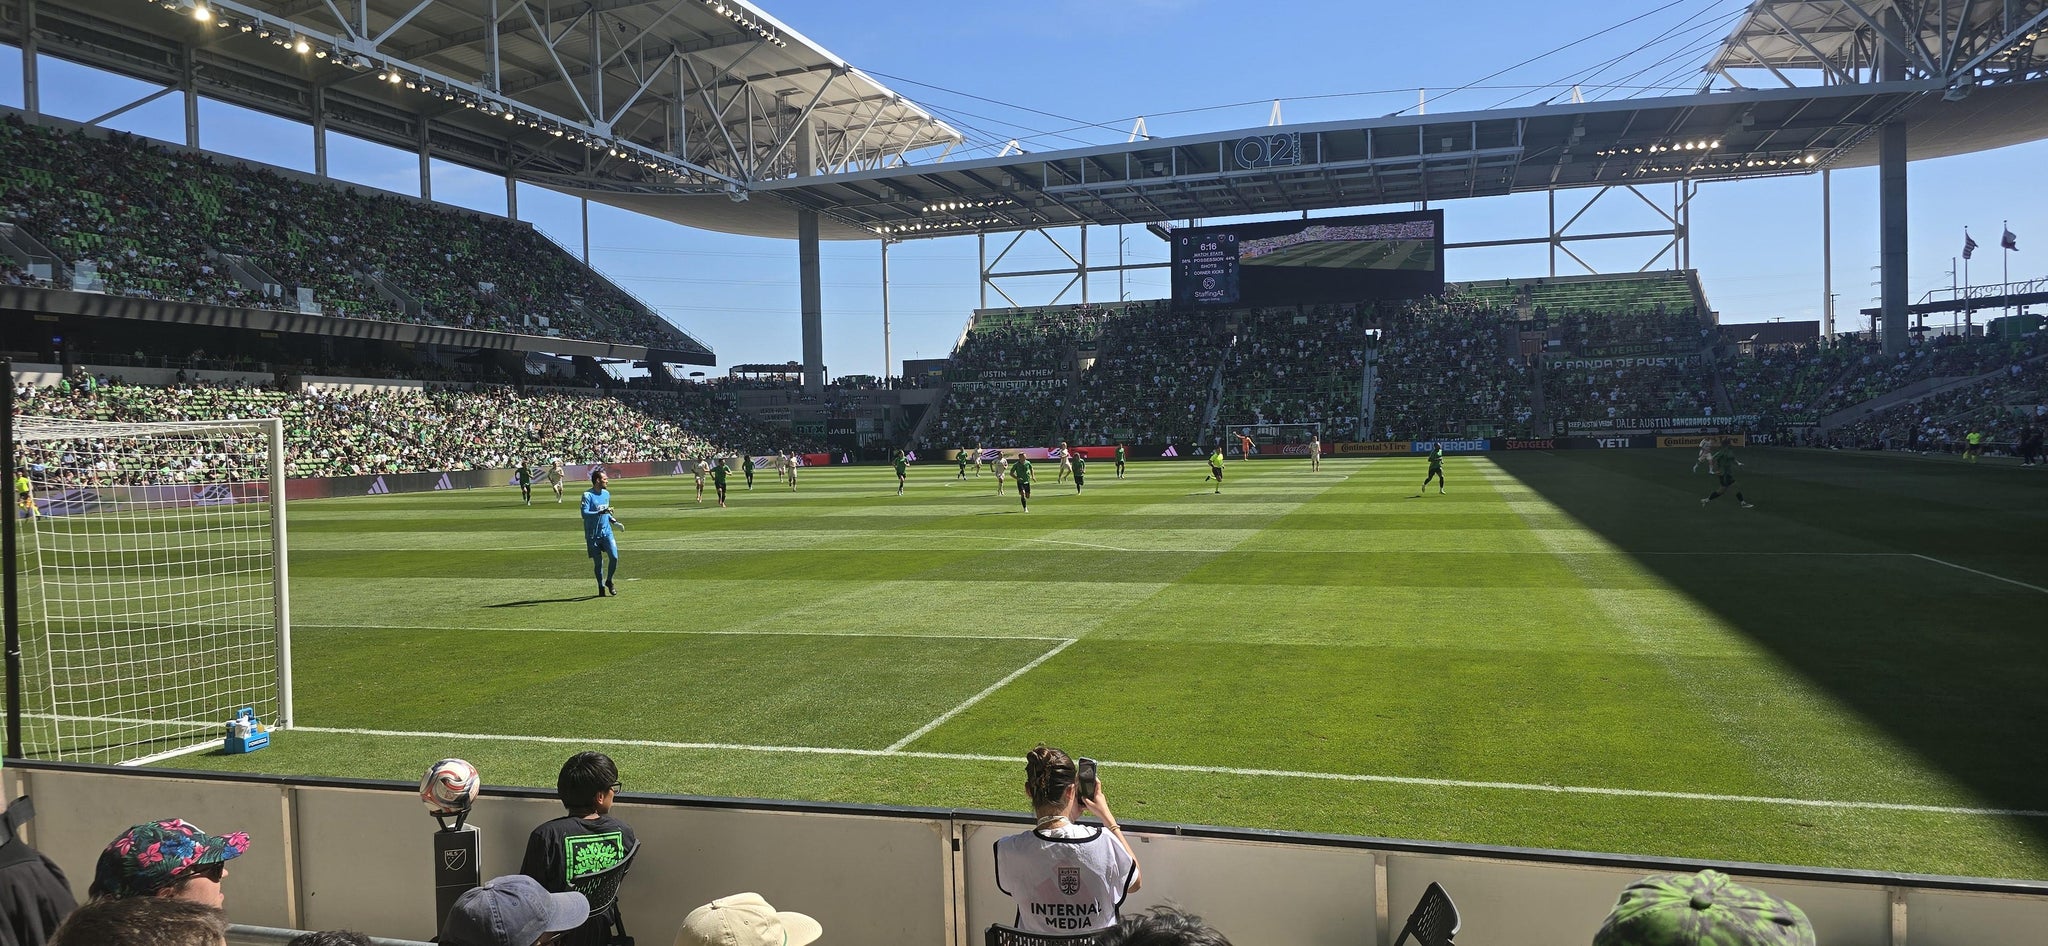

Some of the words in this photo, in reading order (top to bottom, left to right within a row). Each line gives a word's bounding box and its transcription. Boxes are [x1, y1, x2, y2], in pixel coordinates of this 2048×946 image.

[1235, 133, 1293, 170] Q2
[1182, 237, 1188, 246] 0
[1228, 234, 1235, 242] 0
[1200, 242, 1217, 251] 6:16
[1611, 344, 1657, 354] VERDES
[1616, 417, 1637, 428] DALE
[1639, 417, 1671, 428] AUSTIN
[1341, 443, 1382, 452] Continental
[1389, 443, 1406, 451] Tire
[1506, 439, 1554, 449] SEATGEEK
[1597, 438, 1630, 448] YETI
[1031, 902, 1102, 917] INTERNAL
[1045, 916, 1092, 930] MEDIA
